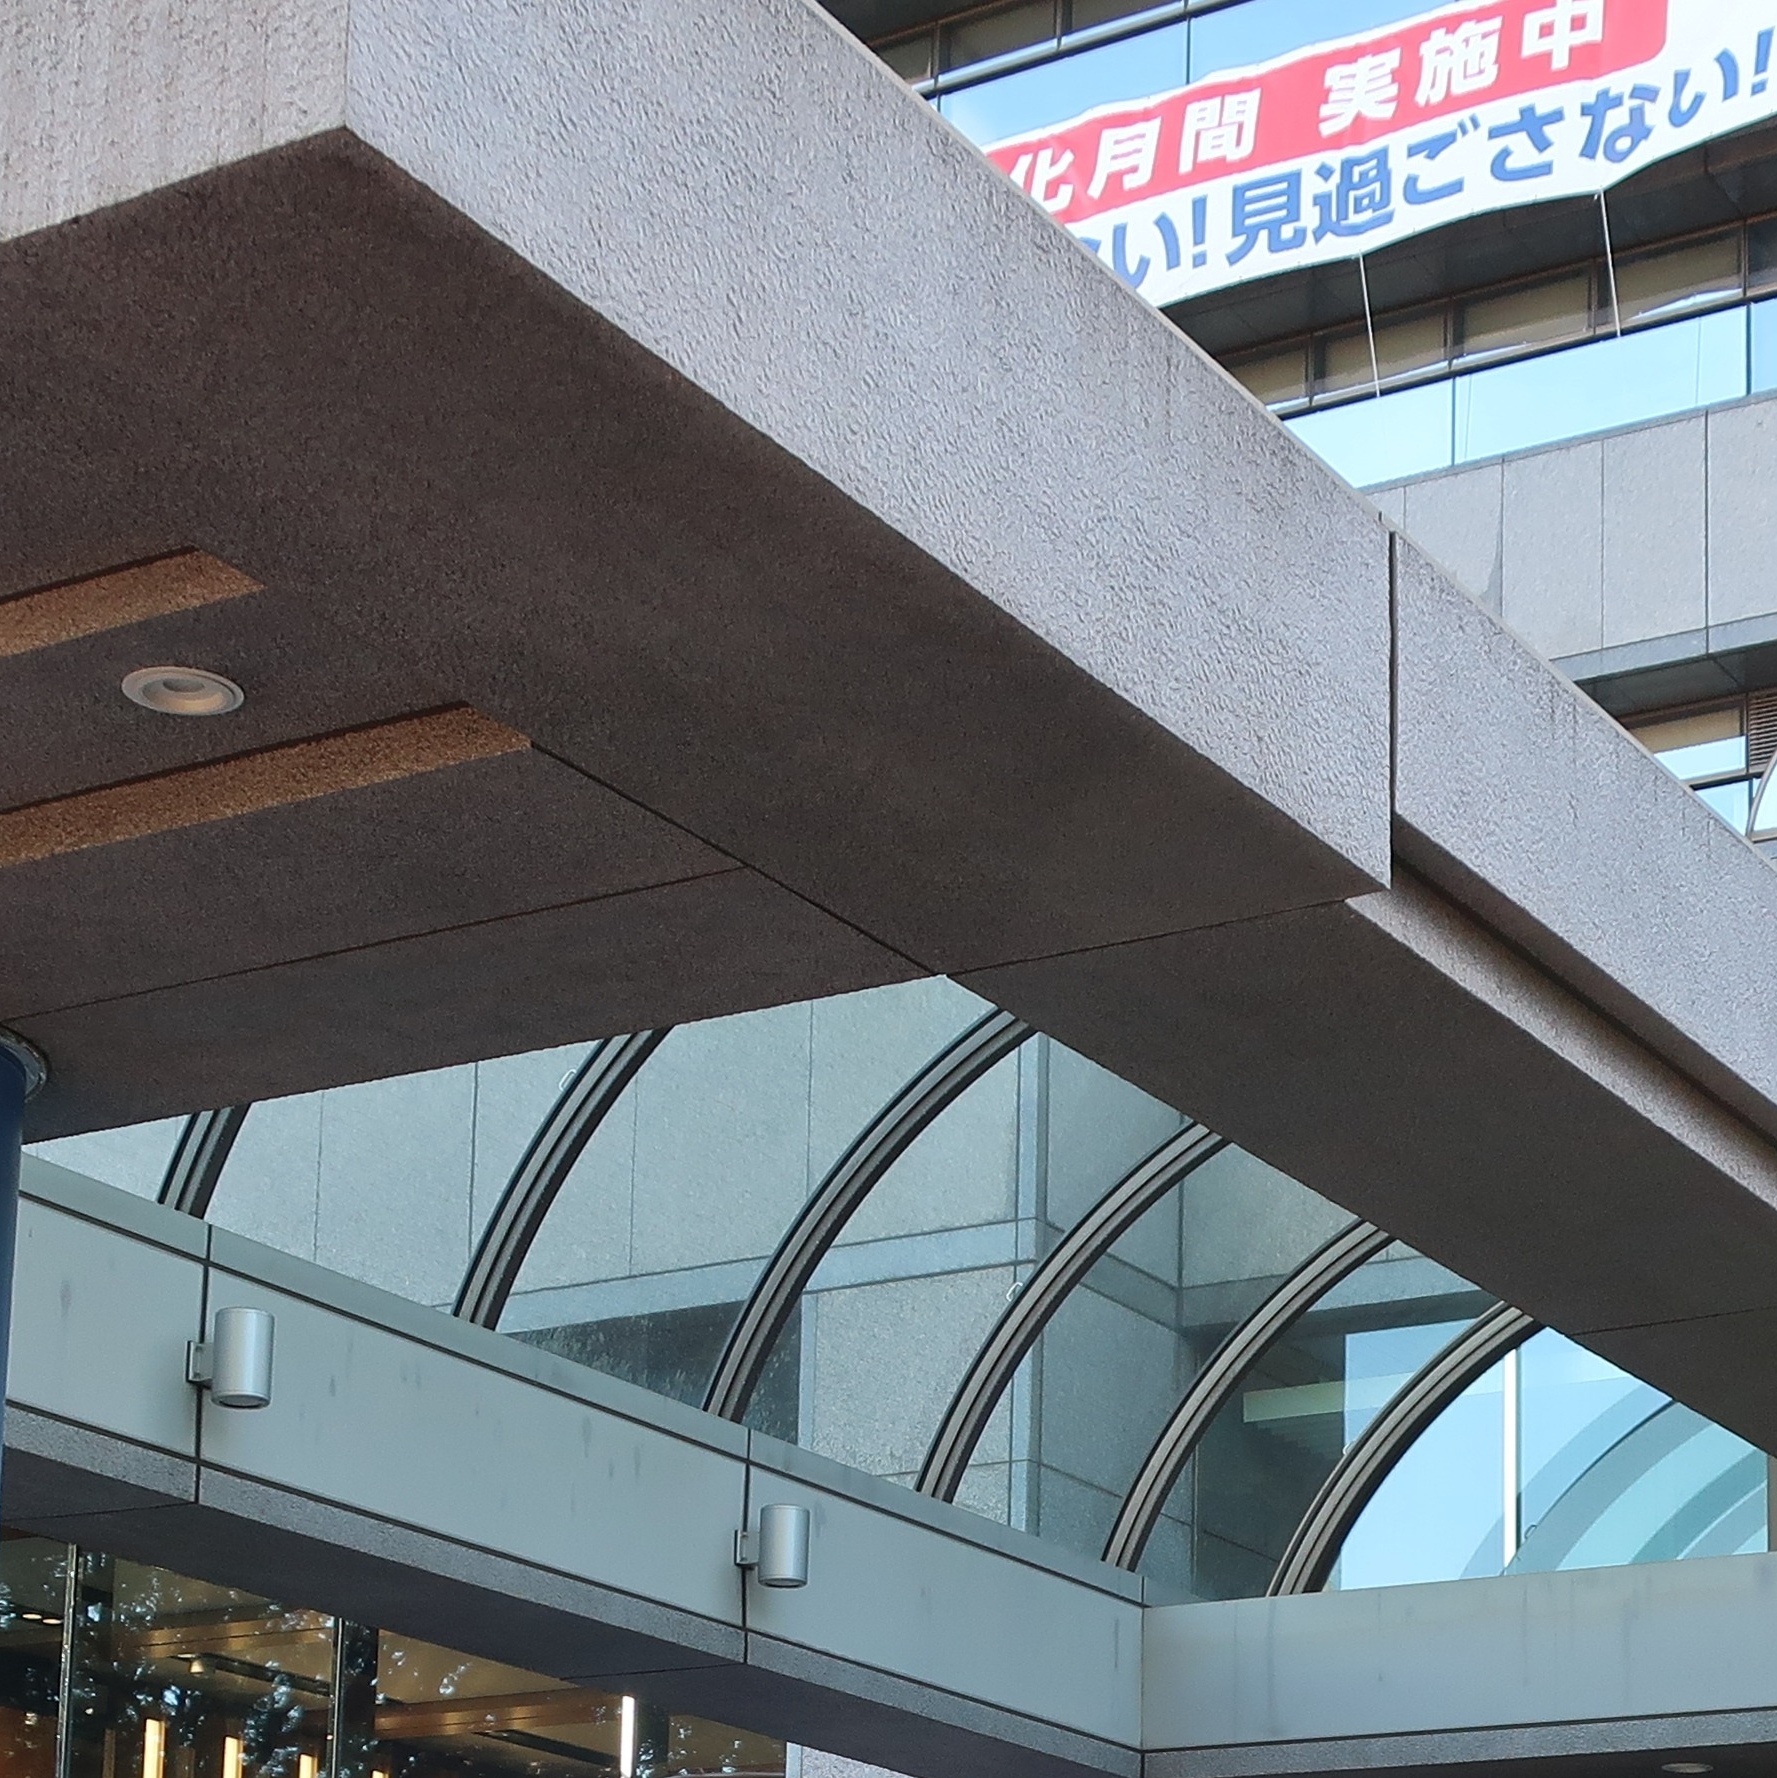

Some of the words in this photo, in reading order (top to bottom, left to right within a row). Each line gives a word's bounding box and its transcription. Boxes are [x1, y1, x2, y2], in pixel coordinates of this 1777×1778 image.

[1009, 89, 1263, 215] 化月間
[1317, 2, 1604, 137] 実施中
[1079, 27, 1775, 291] い!見過ごさない!
